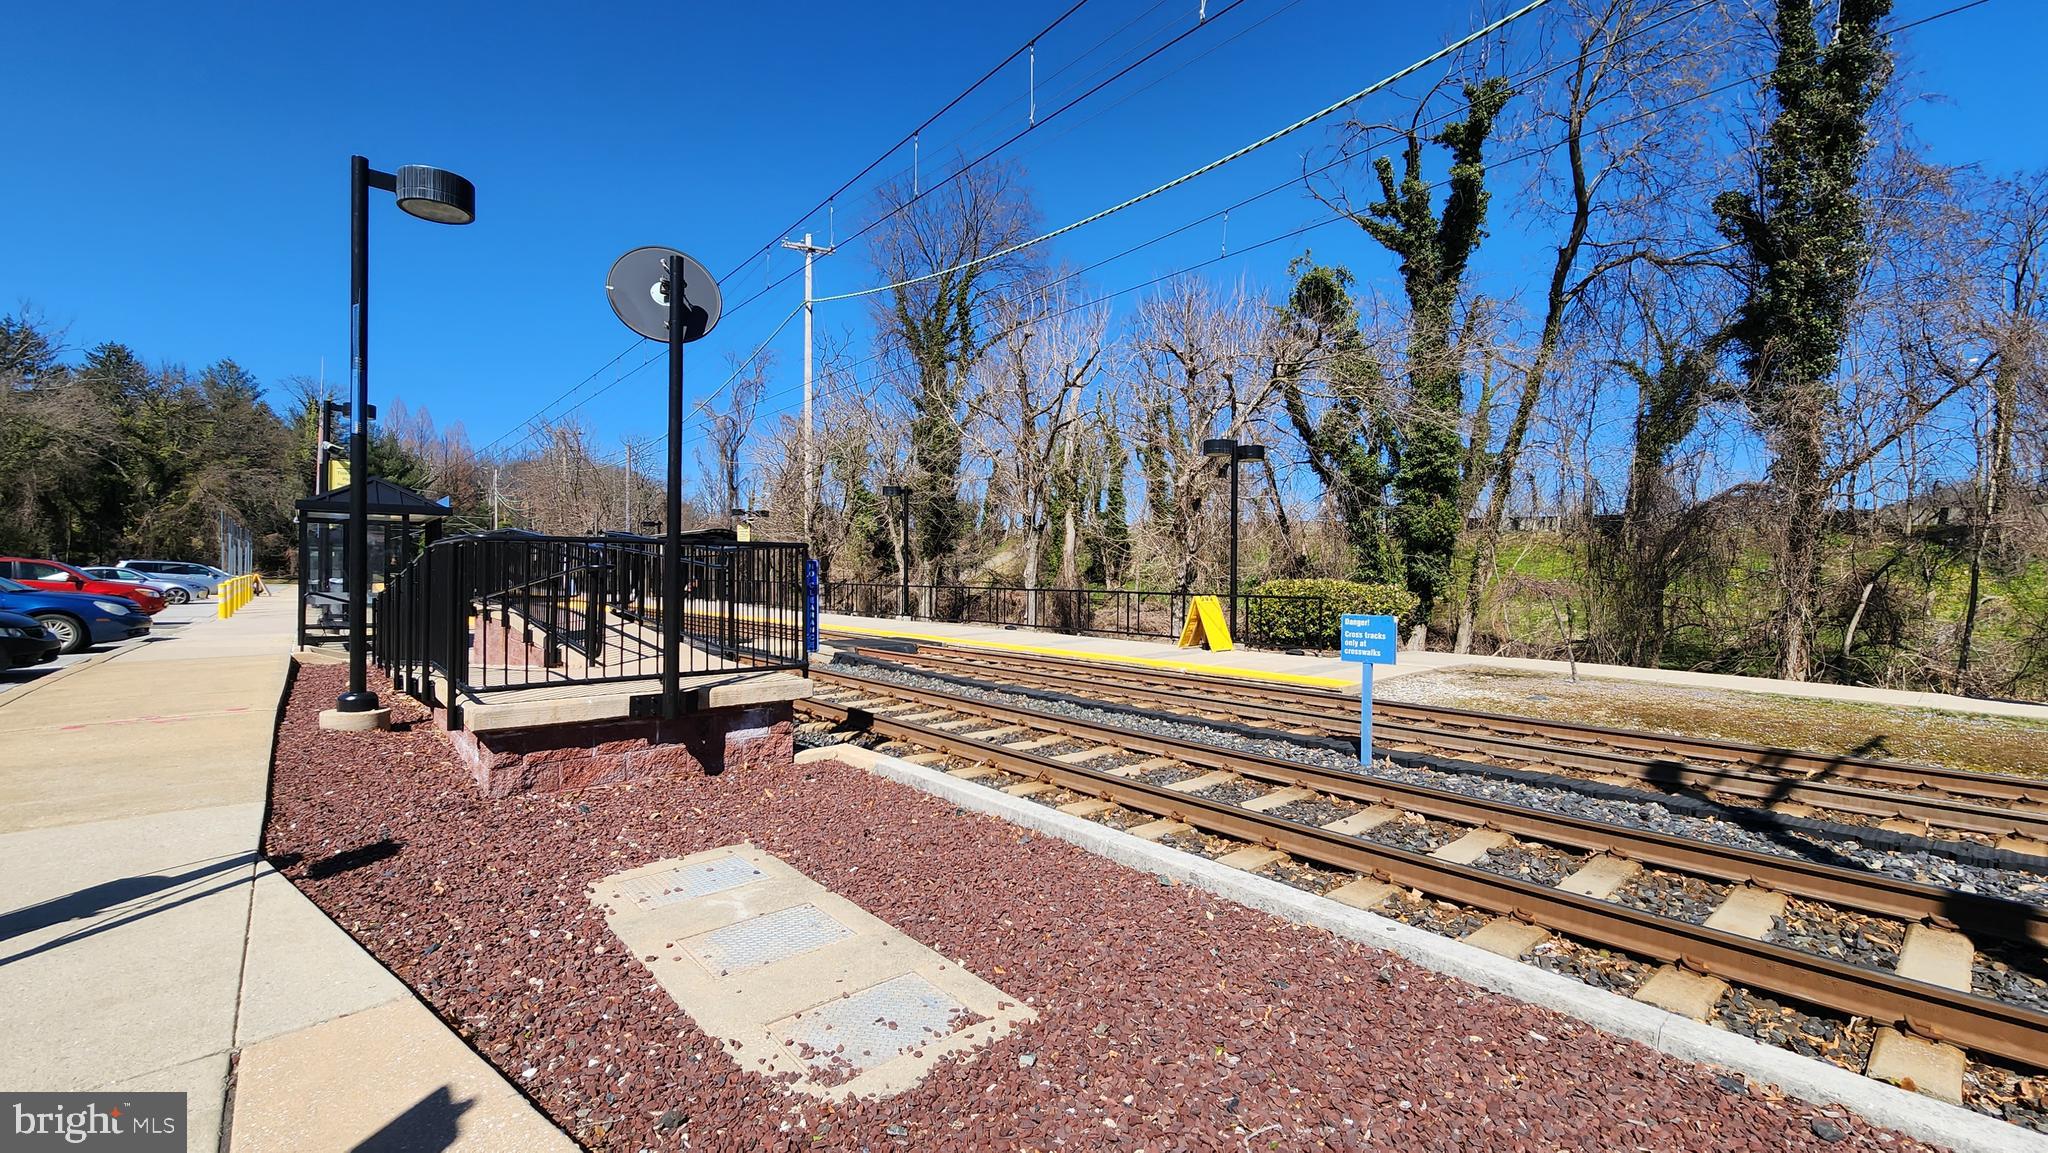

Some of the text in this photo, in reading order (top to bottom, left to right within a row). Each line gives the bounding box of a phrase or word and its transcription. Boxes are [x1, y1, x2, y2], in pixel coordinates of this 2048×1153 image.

[1344, 618, 1370, 627] Danger!
[1344, 630, 1386, 640] Cross tracks
[1344, 648, 1381, 657] crosswalks
